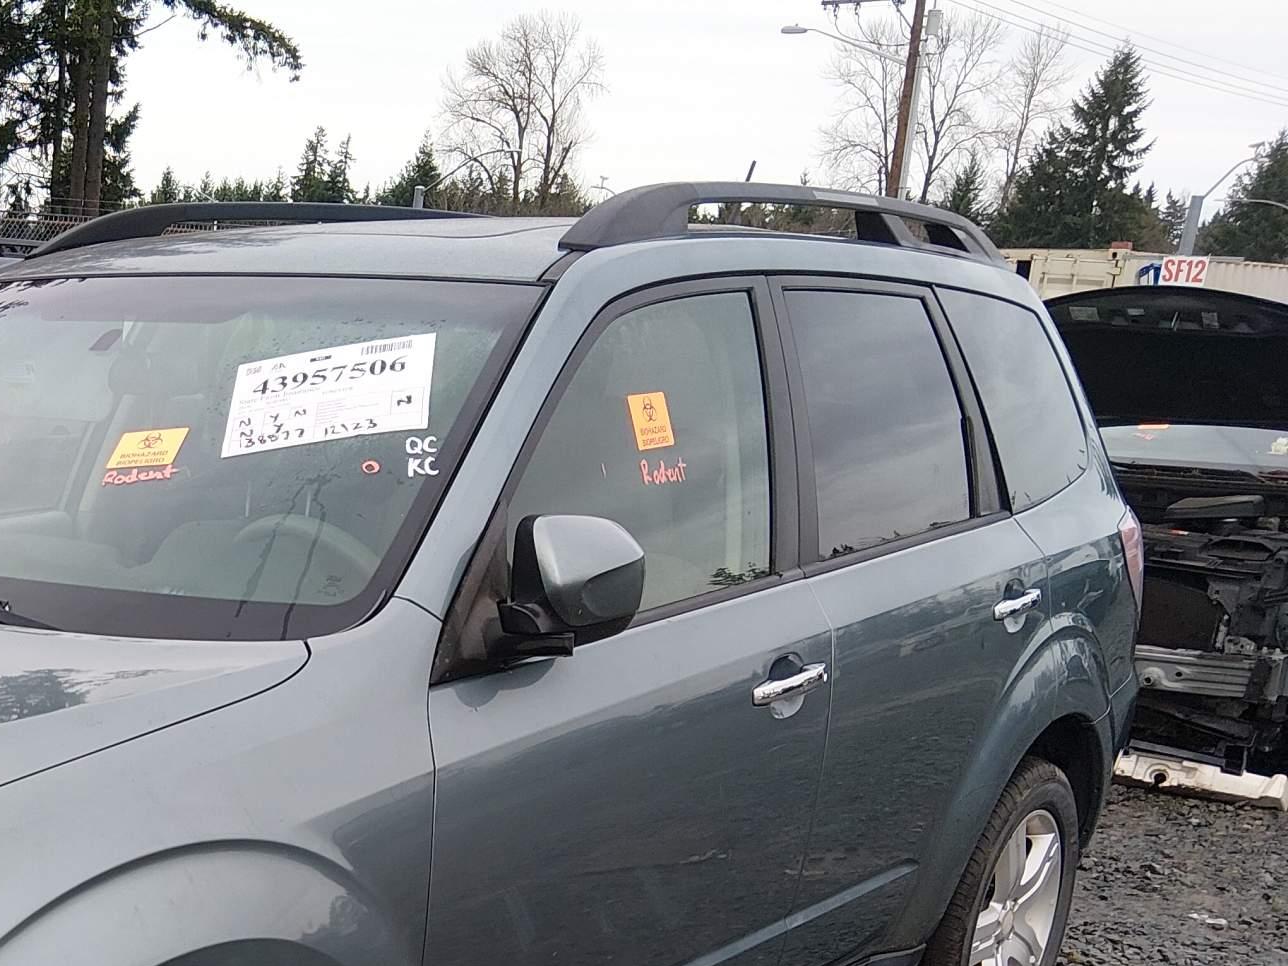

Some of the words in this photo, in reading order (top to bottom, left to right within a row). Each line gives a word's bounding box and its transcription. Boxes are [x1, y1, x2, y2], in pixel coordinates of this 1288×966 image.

[1161, 259, 1207, 283] SF12
[252, 355, 409, 395] 43957506
[119, 450, 169, 459] BIOHAZARD
[405, 436, 438, 454] QC
[101, 465, 180, 487] Rodent
[407, 456, 440, 478] KC
[640, 457, 687, 486] Rodent
